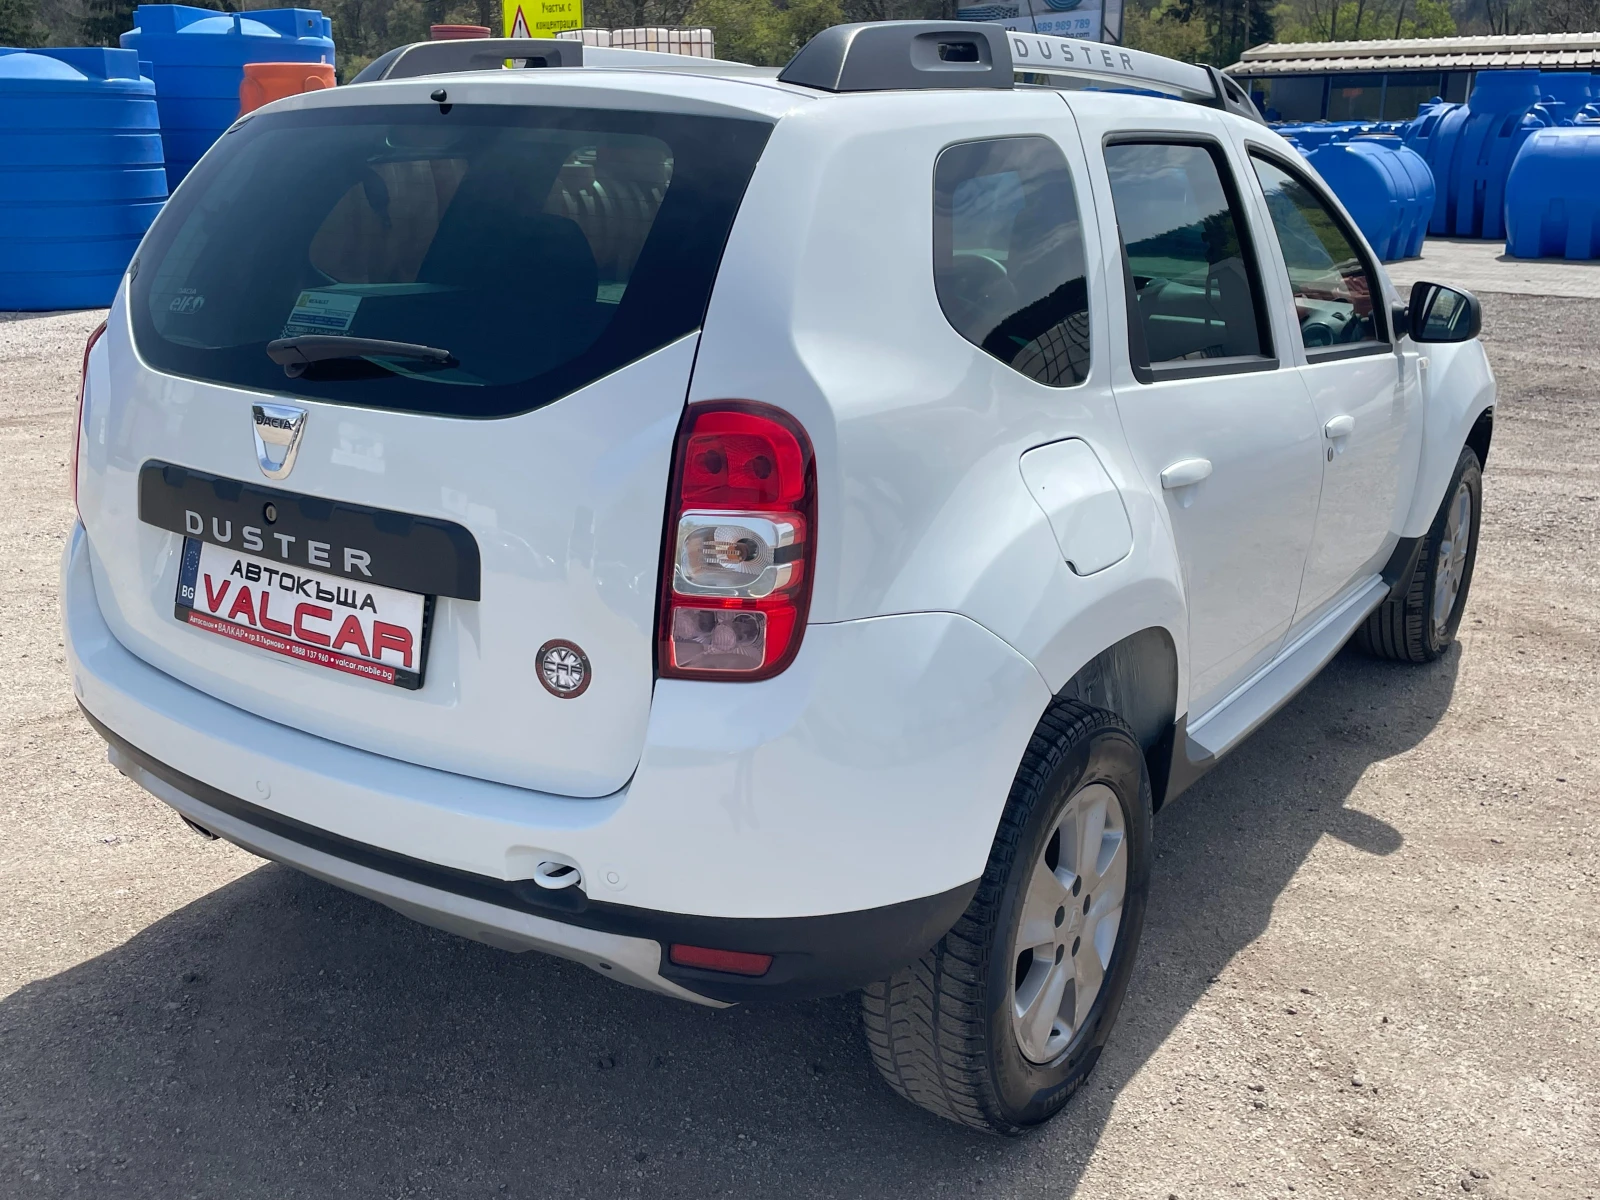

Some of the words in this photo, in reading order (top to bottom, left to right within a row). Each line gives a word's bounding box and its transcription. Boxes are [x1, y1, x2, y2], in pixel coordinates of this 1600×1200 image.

[542, 2, 565, 13] Участък
[536, 20, 578, 30] концентрация
[1055, 20, 1072, 32] 989
[1074, 18, 1091, 30] 789
[1013, 38, 1135, 71] DUSTER
[169, 296, 195, 312] elf
[256, 415, 293, 431] DACIA
[185, 509, 373, 577] DUSTER
[181, 585, 194, 600] BG
[230, 559, 378, 615] АВТОКЪЩА
[203, 573, 413, 668] VALCAR
[189, 615, 215, 629] Автосалон
[217, 623, 245, 638] ВАЛКАР
[292, 645, 306, 656] 0888
[306, 649, 317, 659] 137
[318, 652, 329, 663] 960
[335, 658, 393, 681] valcar.mobile.bg
